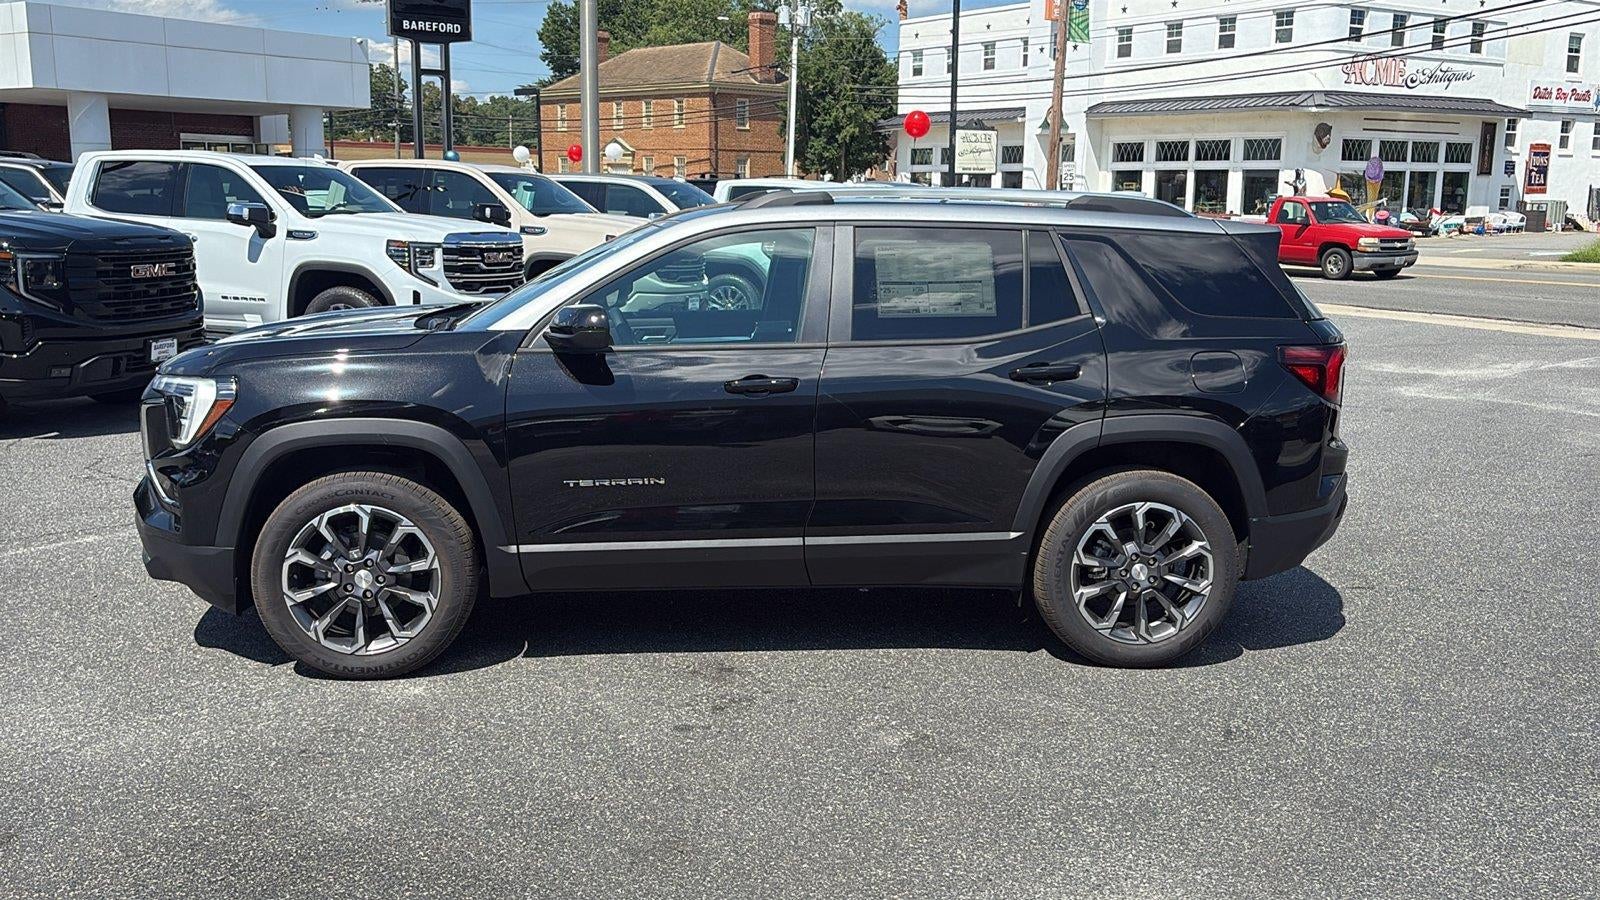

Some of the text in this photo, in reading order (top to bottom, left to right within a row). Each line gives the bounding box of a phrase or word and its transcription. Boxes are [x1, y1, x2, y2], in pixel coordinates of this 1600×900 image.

[402, 20, 461, 33] BAREFORD
[1341, 52, 1407, 88] ACME
[1420, 60, 1475, 90] Antiques
[1532, 86, 1592, 103] Dutch Boy Paints
[1063, 172, 1075, 181] 25
[1530, 171, 1545, 184] TEA
[484, 252, 514, 264] GMC
[130, 263, 177, 279] GMC
[563, 477, 666, 488] TERRAIN
